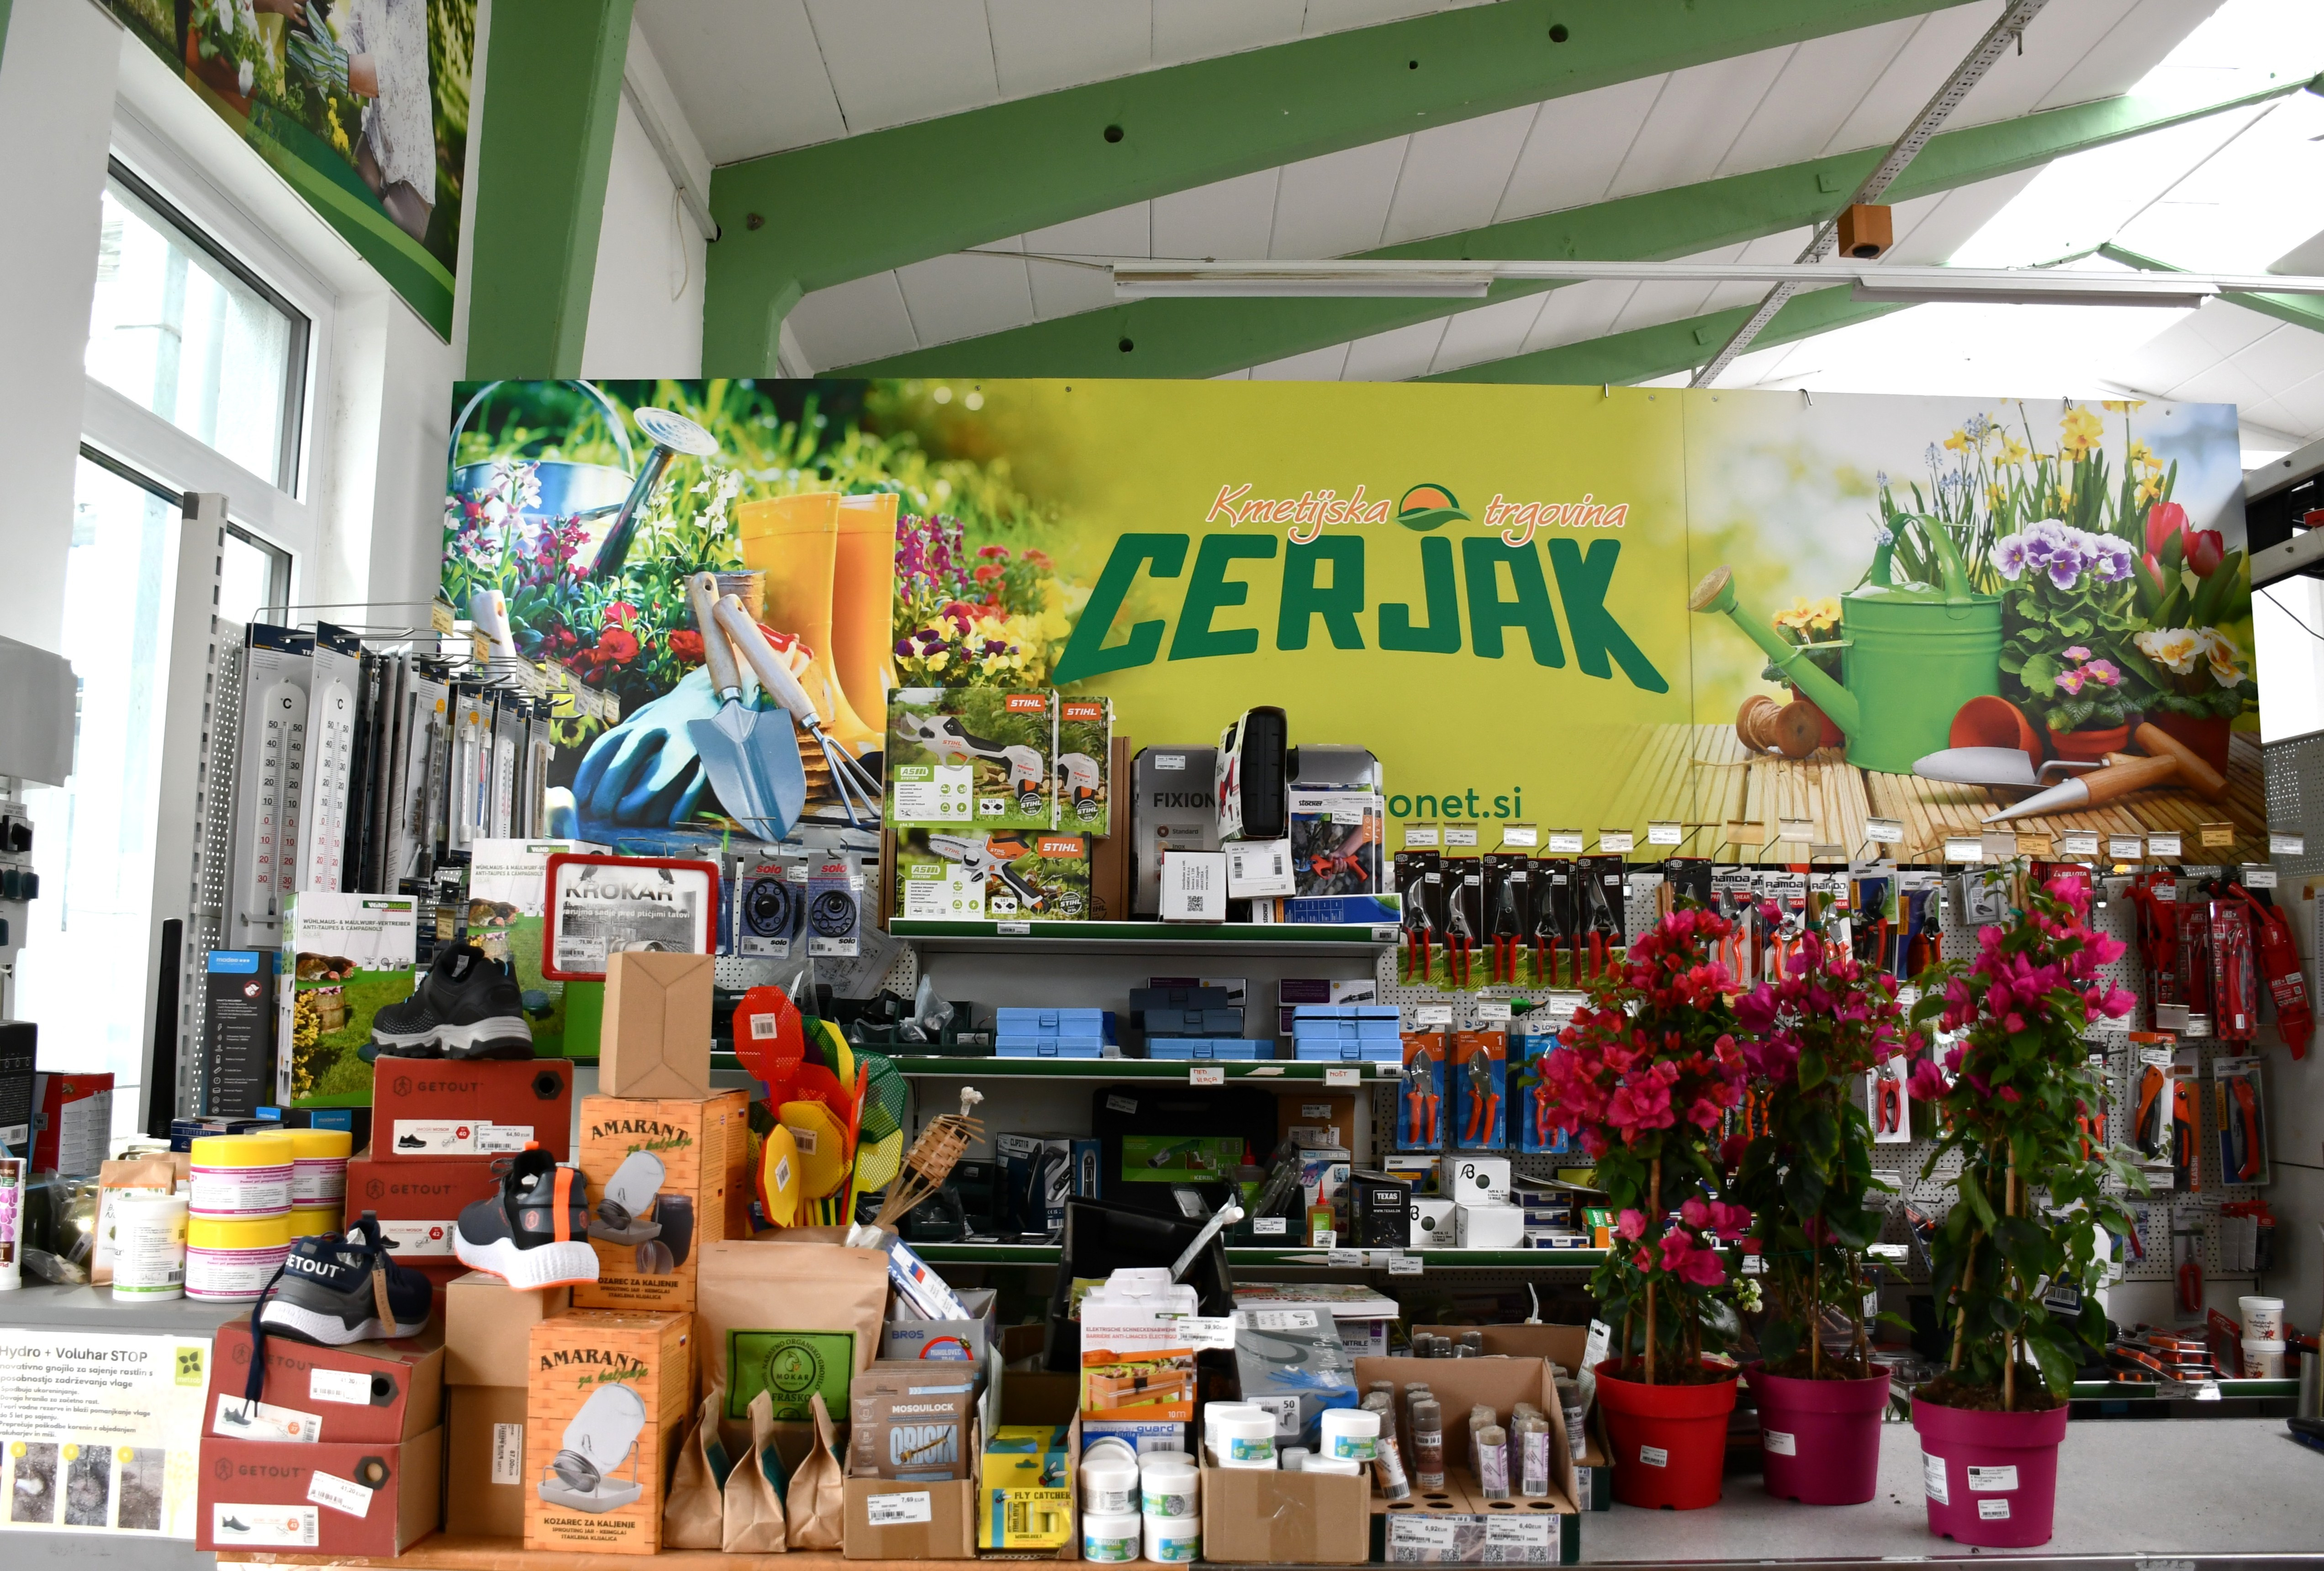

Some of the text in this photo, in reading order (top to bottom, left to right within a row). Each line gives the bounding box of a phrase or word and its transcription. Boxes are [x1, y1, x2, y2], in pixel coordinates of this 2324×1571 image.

[1206, 483, 1629, 548] Kmetijska trgovina
[1051, 534, 1669, 693] CERJAK
[1010, 699, 1041, 707] STIHL
[1154, 793, 1215, 808] FIXION
[1384, 786, 1521, 818] onet.si
[1077, 806, 1098, 815] STIHL
[1043, 842, 1078, 852] STIHL
[756, 864, 782, 874] solo
[821, 863, 847, 873] solo
[566, 881, 674, 901] KROKAR
[1437, 1037, 1442, 1047] 1
[1497, 1036, 1502, 1046] 1
[418, 1082, 479, 1092] GETOUT
[592, 1119, 688, 1140] AMARANT
[391, 1185, 450, 1194] GETOUT
[892, 1330, 924, 1339] BROS
[0, 1346, 148, 1362] Hydro Voluhar STOP
[540, 1349, 644, 1371] AMARANT
[762, 1338, 825, 1390] NARAVNO ORGANSKO GNOJILO
[46, 1365, 74, 1373] gnojilo
[89, 1366, 117, 1376] sajenje
[0, 1375, 132, 1389] posobnostjo zadrževanja vlage
[893, 1403, 954, 1413] MOSQUILOCK
[1283, 1400, 1294, 1408] 50
[890, 1425, 957, 1465] ORIGIN
[239, 1465, 299, 1477] GETOUT
[544, 1518, 581, 1526] KOZAREC
